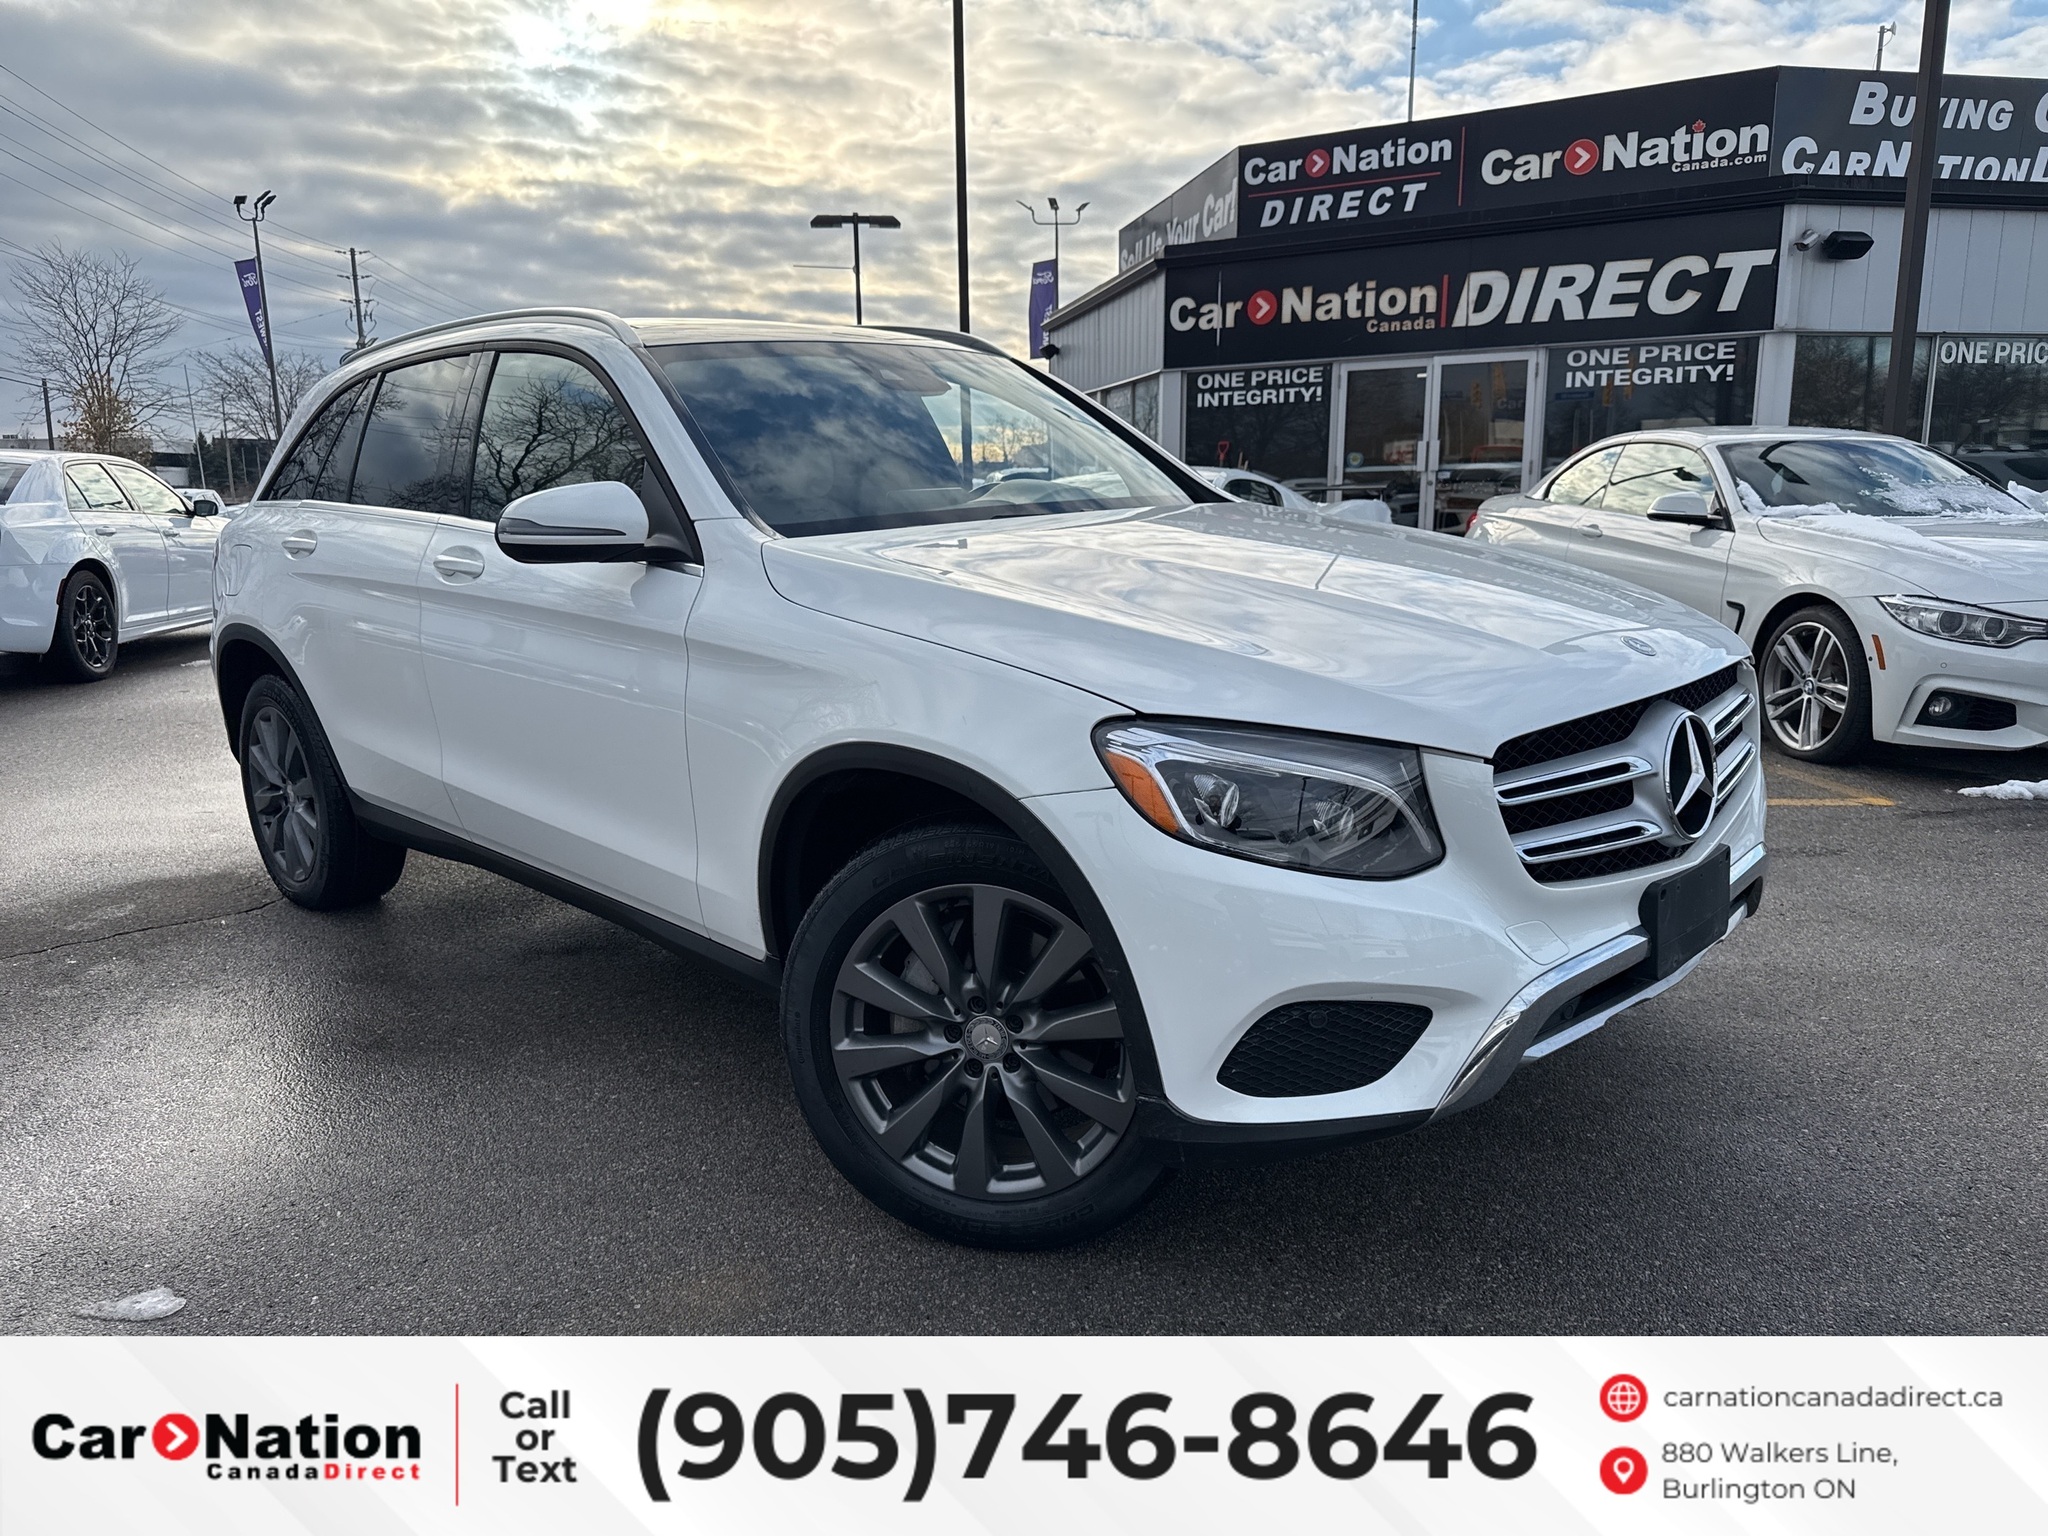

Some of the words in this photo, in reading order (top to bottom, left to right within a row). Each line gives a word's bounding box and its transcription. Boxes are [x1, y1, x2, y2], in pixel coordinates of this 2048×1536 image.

[1849, 81, 2014, 131] BUING
[1244, 157, 1303, 186] Car
[1332, 138, 1453, 175] Nation
[1481, 148, 1562, 186] Car
[1602, 122, 1770, 172] Nation
[1671, 154, 1768, 173] Canada.com
[1781, 136, 2048, 183] CARNTION
[1166, 212, 1200, 246] Your
[1202, 176, 1238, 238] Car!
[1260, 182, 1428, 228] DIRECT
[1169, 297, 1243, 332] Car
[1281, 279, 1438, 325] Nation
[1451, 248, 1778, 328] DIRECT
[1366, 316, 1436, 333] Canada
[1567, 347, 1630, 367] ONE
[1639, 341, 1737, 363] PRICE
[1941, 341, 1990, 364] ONE
[1197, 371, 1245, 389] ONE
[1250, 366, 1324, 387] PRICE
[1566, 364, 1735, 388] INTEGRITY!
[1197, 386, 1323, 408] INTEGRITY!
